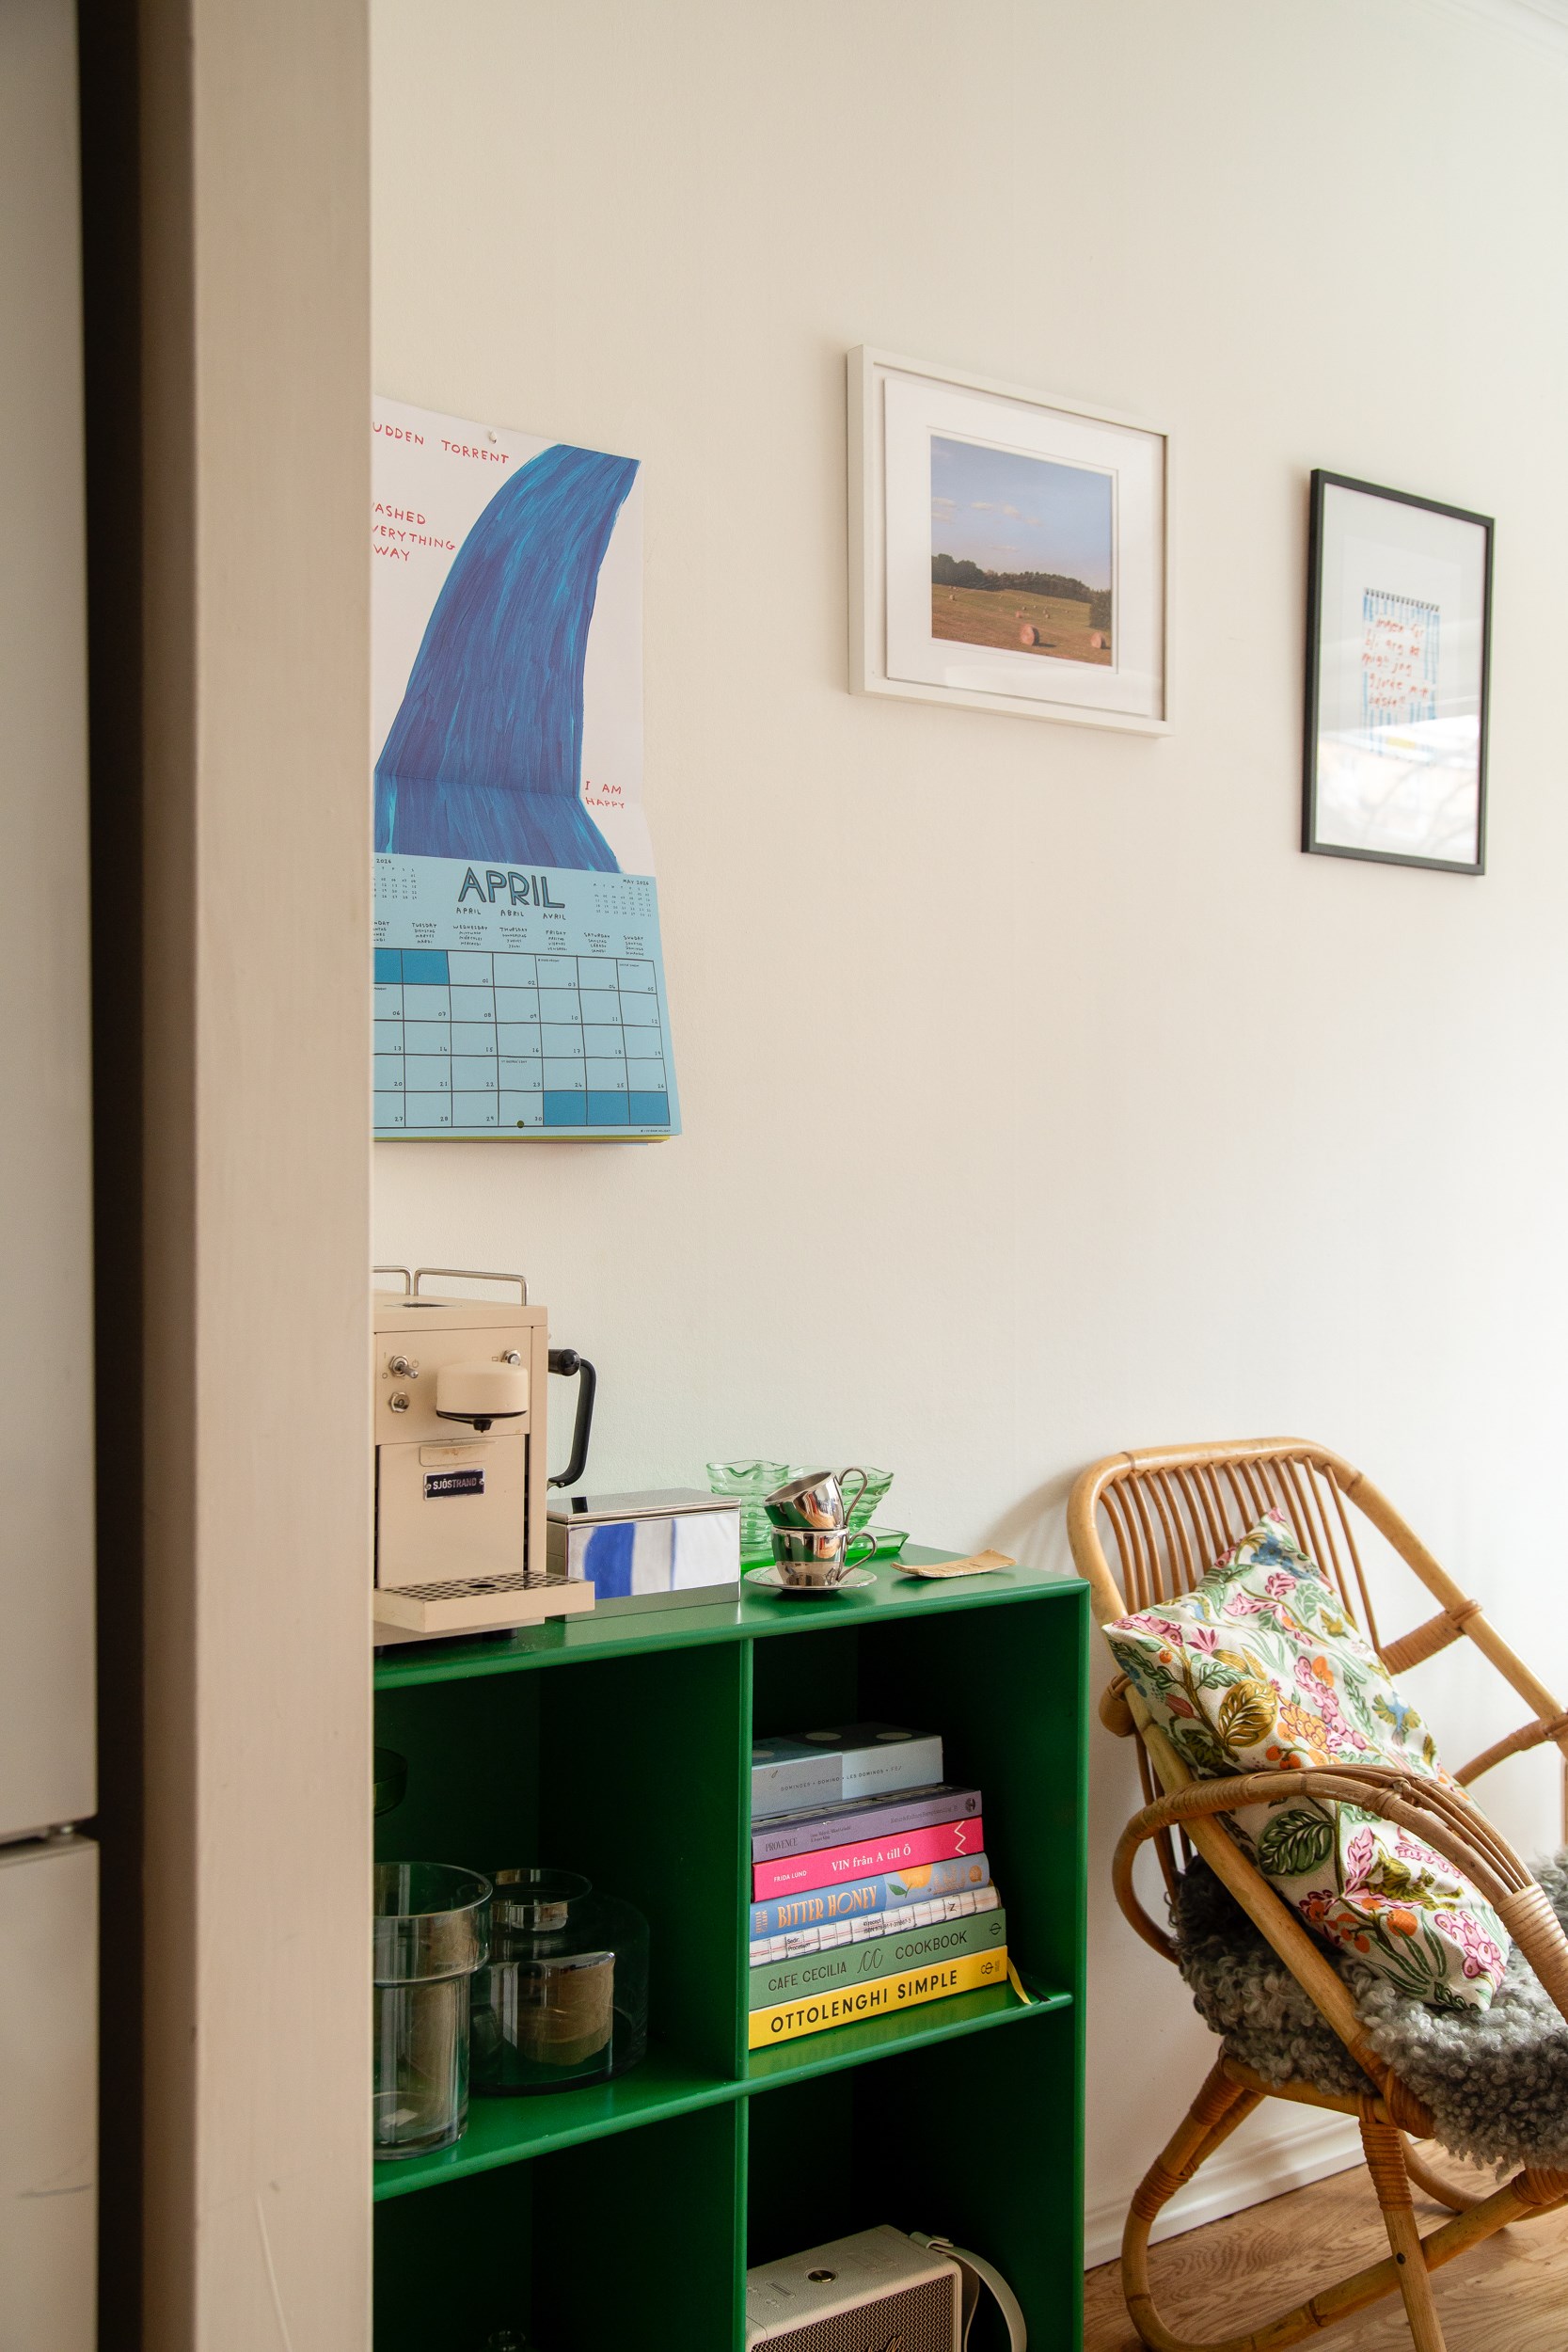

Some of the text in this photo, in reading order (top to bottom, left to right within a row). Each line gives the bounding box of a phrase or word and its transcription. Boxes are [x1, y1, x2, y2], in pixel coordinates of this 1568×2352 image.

[372, 421, 509, 464] UDDEN TORRENT
[372, 502, 426, 525] ASHED
[372, 544, 410, 562] WAY
[585, 781, 622, 795] I AM
[585, 797, 625, 810] HAPPY
[458, 866, 565, 909] APRIL
[456, 907, 566, 921] APRIL ABRIL AVRIL
[433, 1478, 477, 1490] SJÖSTRAND
[765, 1837, 798, 1852] PROVENCE
[832, 1857, 849, 1871] VIN
[853, 1854, 873, 1867] från
[877, 1851, 883, 1862] A
[887, 1846, 900, 1859] till
[773, 1873, 790, 1883] FRIDA
[777, 1885, 878, 1928] BITTER HONEY
[768, 1976, 798, 1992] CAFE
[802, 1963, 847, 1984] CECILIA
[895, 1931, 967, 1960] COOKBOOK
[770, 1970, 958, 2033] OTTOLENGHI SIMPLE
